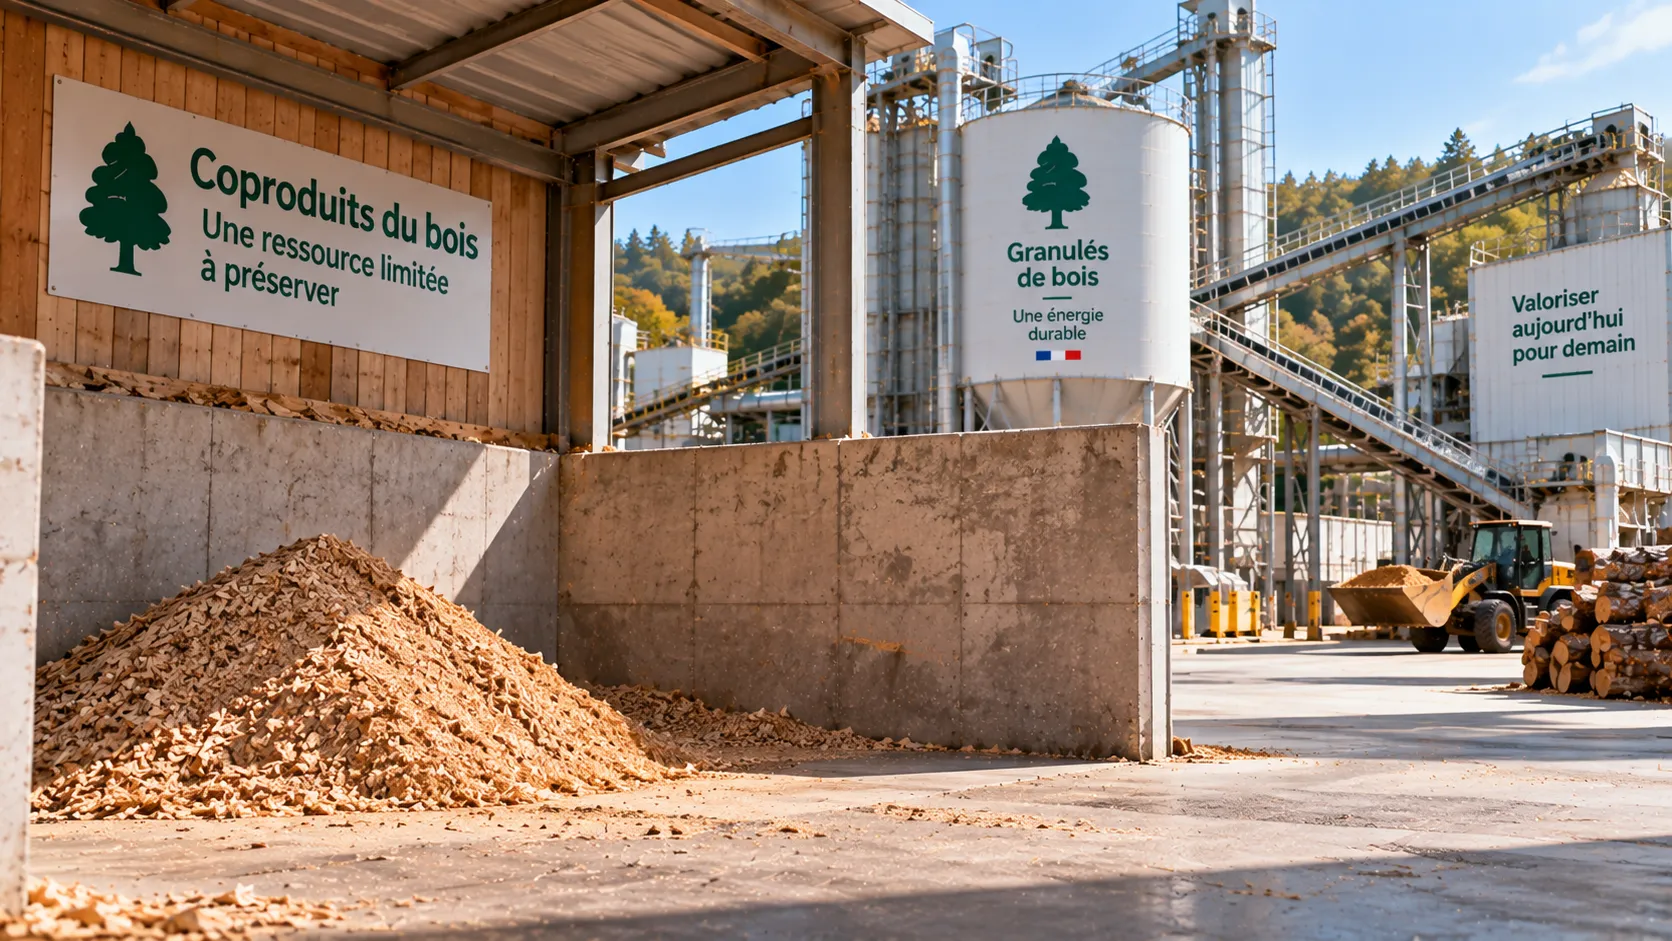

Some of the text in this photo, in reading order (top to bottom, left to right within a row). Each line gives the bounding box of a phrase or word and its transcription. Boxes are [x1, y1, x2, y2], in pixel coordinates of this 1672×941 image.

[190, 147, 479, 260] Coproduits du bois
[203, 208, 449, 295] Une ressource limitée
[1007, 239, 1109, 263] Granulés
[201, 249, 340, 307] à préserver
[1017, 265, 1099, 288] de bois
[1512, 289, 1599, 313] Valoriser
[1013, 307, 1104, 325] Une énergie
[1512, 308, 1624, 340] aujourd'hui
[1028, 325, 1087, 341] durable
[1513, 333, 1636, 366] pour demain
